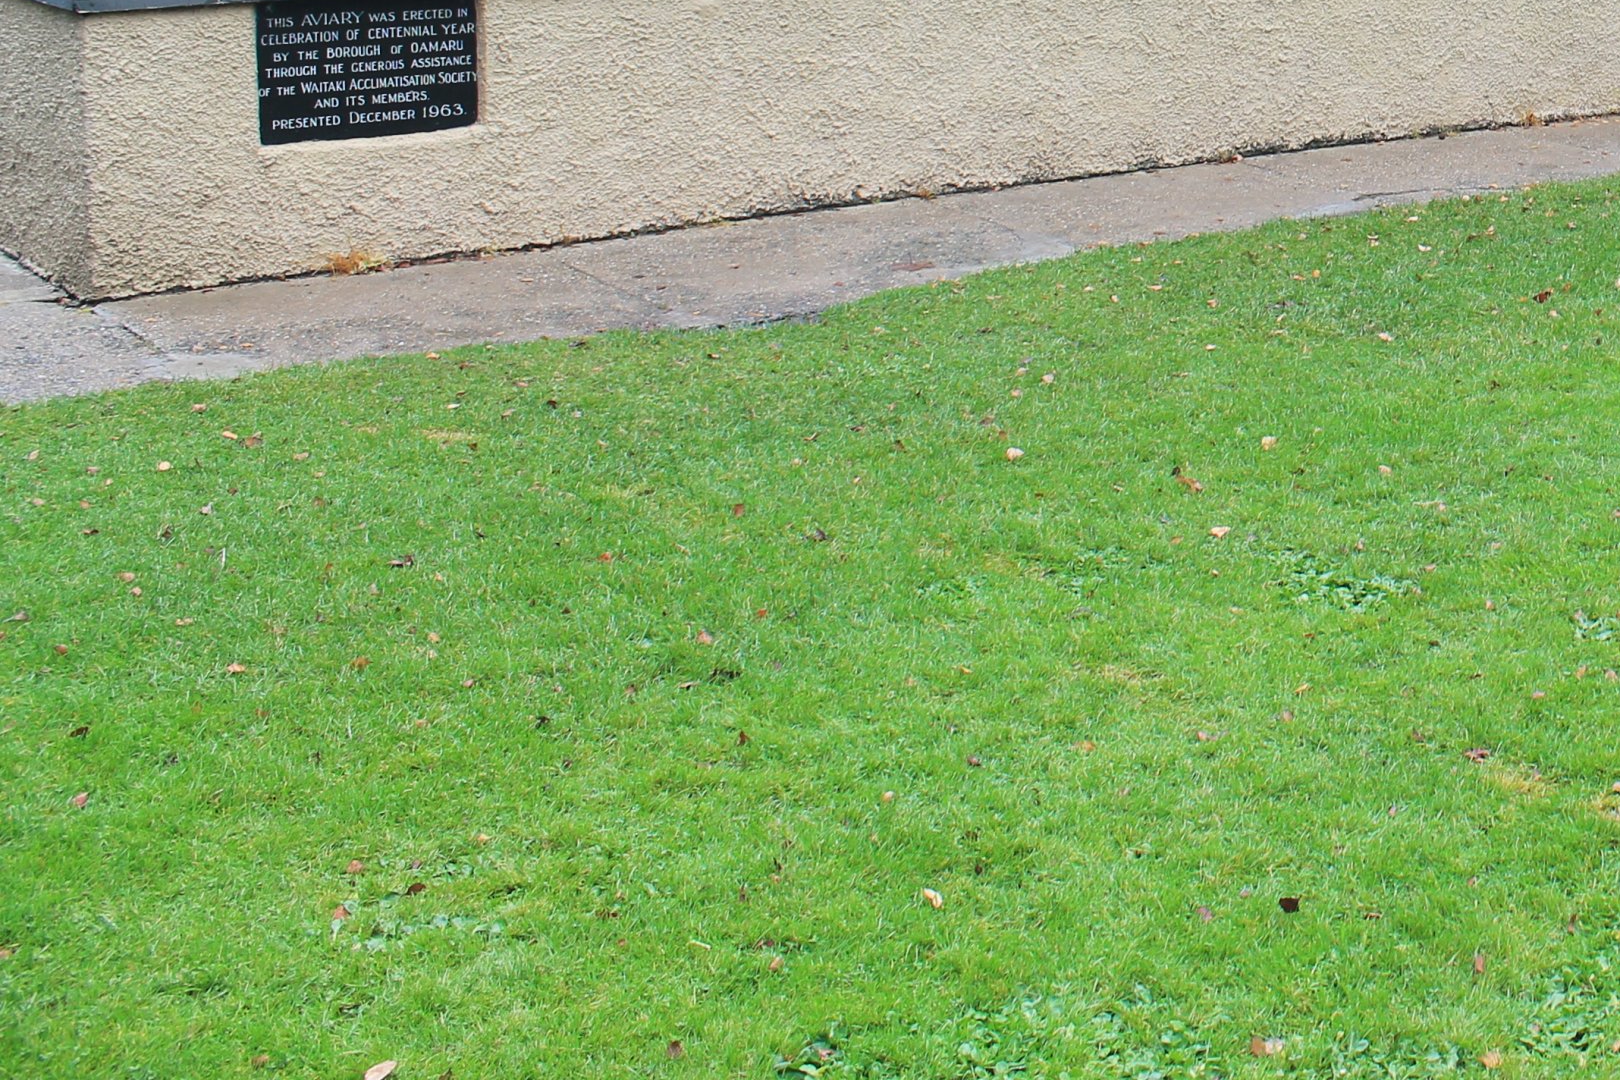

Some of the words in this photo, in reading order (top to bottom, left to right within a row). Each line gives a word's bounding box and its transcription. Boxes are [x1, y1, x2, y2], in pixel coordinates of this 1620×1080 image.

[266, 17, 294, 28] THIS
[301, 11, 364, 26] AVIARY
[368, 11, 396, 22] WAS
[403, 9, 452, 21] ERECTED
[457, 8, 468, 18] IN
[261, 30, 339, 46] CELEBRATION
[346, 28, 360, 41] OF
[368, 25, 437, 40] CENTENNIAL
[441, 22, 475, 35] YEAR
[273, 52, 289, 62] BY
[297, 50, 319, 60] THE
[326, 44, 381, 59] BOROUGH
[411, 40, 464, 54] OAMARU
[265, 65, 317, 79] THROUGH
[324, 63, 344, 75] THE
[351, 59, 405, 73] GENEROUS
[411, 55, 472, 69] ASSISTANCE
[258, 88, 271, 98] OF
[276, 86, 296, 96] THE
[300, 80, 346, 94] WAITAKI
[349, 73, 436, 91] ACCLIMATISATION
[438, 71, 477, 84] SOCIETY
[314, 97, 339, 109] AND
[346, 95, 365, 107] ITS
[272, 115, 341, 130] PRESENTED
[349, 109, 416, 125] DECEMBER
